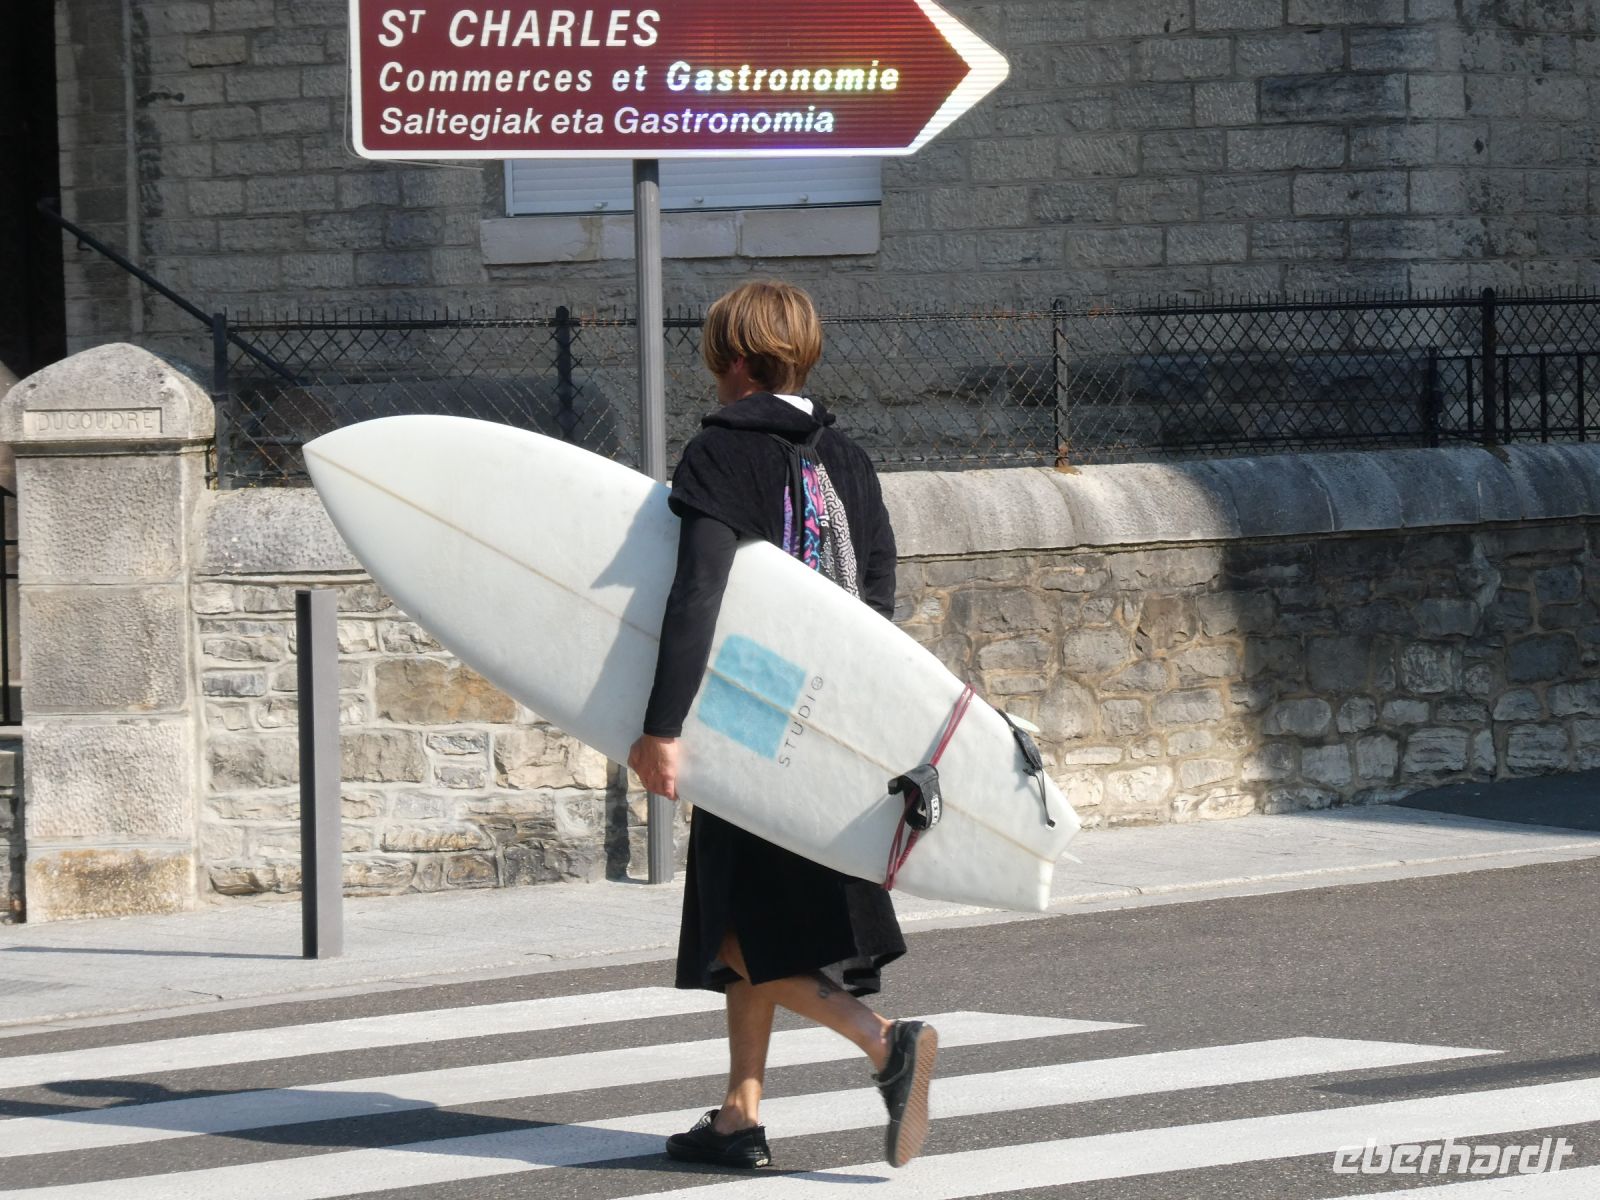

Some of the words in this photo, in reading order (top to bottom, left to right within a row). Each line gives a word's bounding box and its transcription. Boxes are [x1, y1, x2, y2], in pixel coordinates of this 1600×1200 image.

[449, 9, 661, 47] CHARLES
[379, 61, 593, 92] Commerces
[612, 65, 648, 92] et
[666, 60, 900, 92] Gastronomie
[380, 106, 543, 141] Saltegiak
[551, 108, 604, 134] eta
[614, 105, 835, 134] Gastronomia
[38, 411, 153, 431] DUCOUDRE
